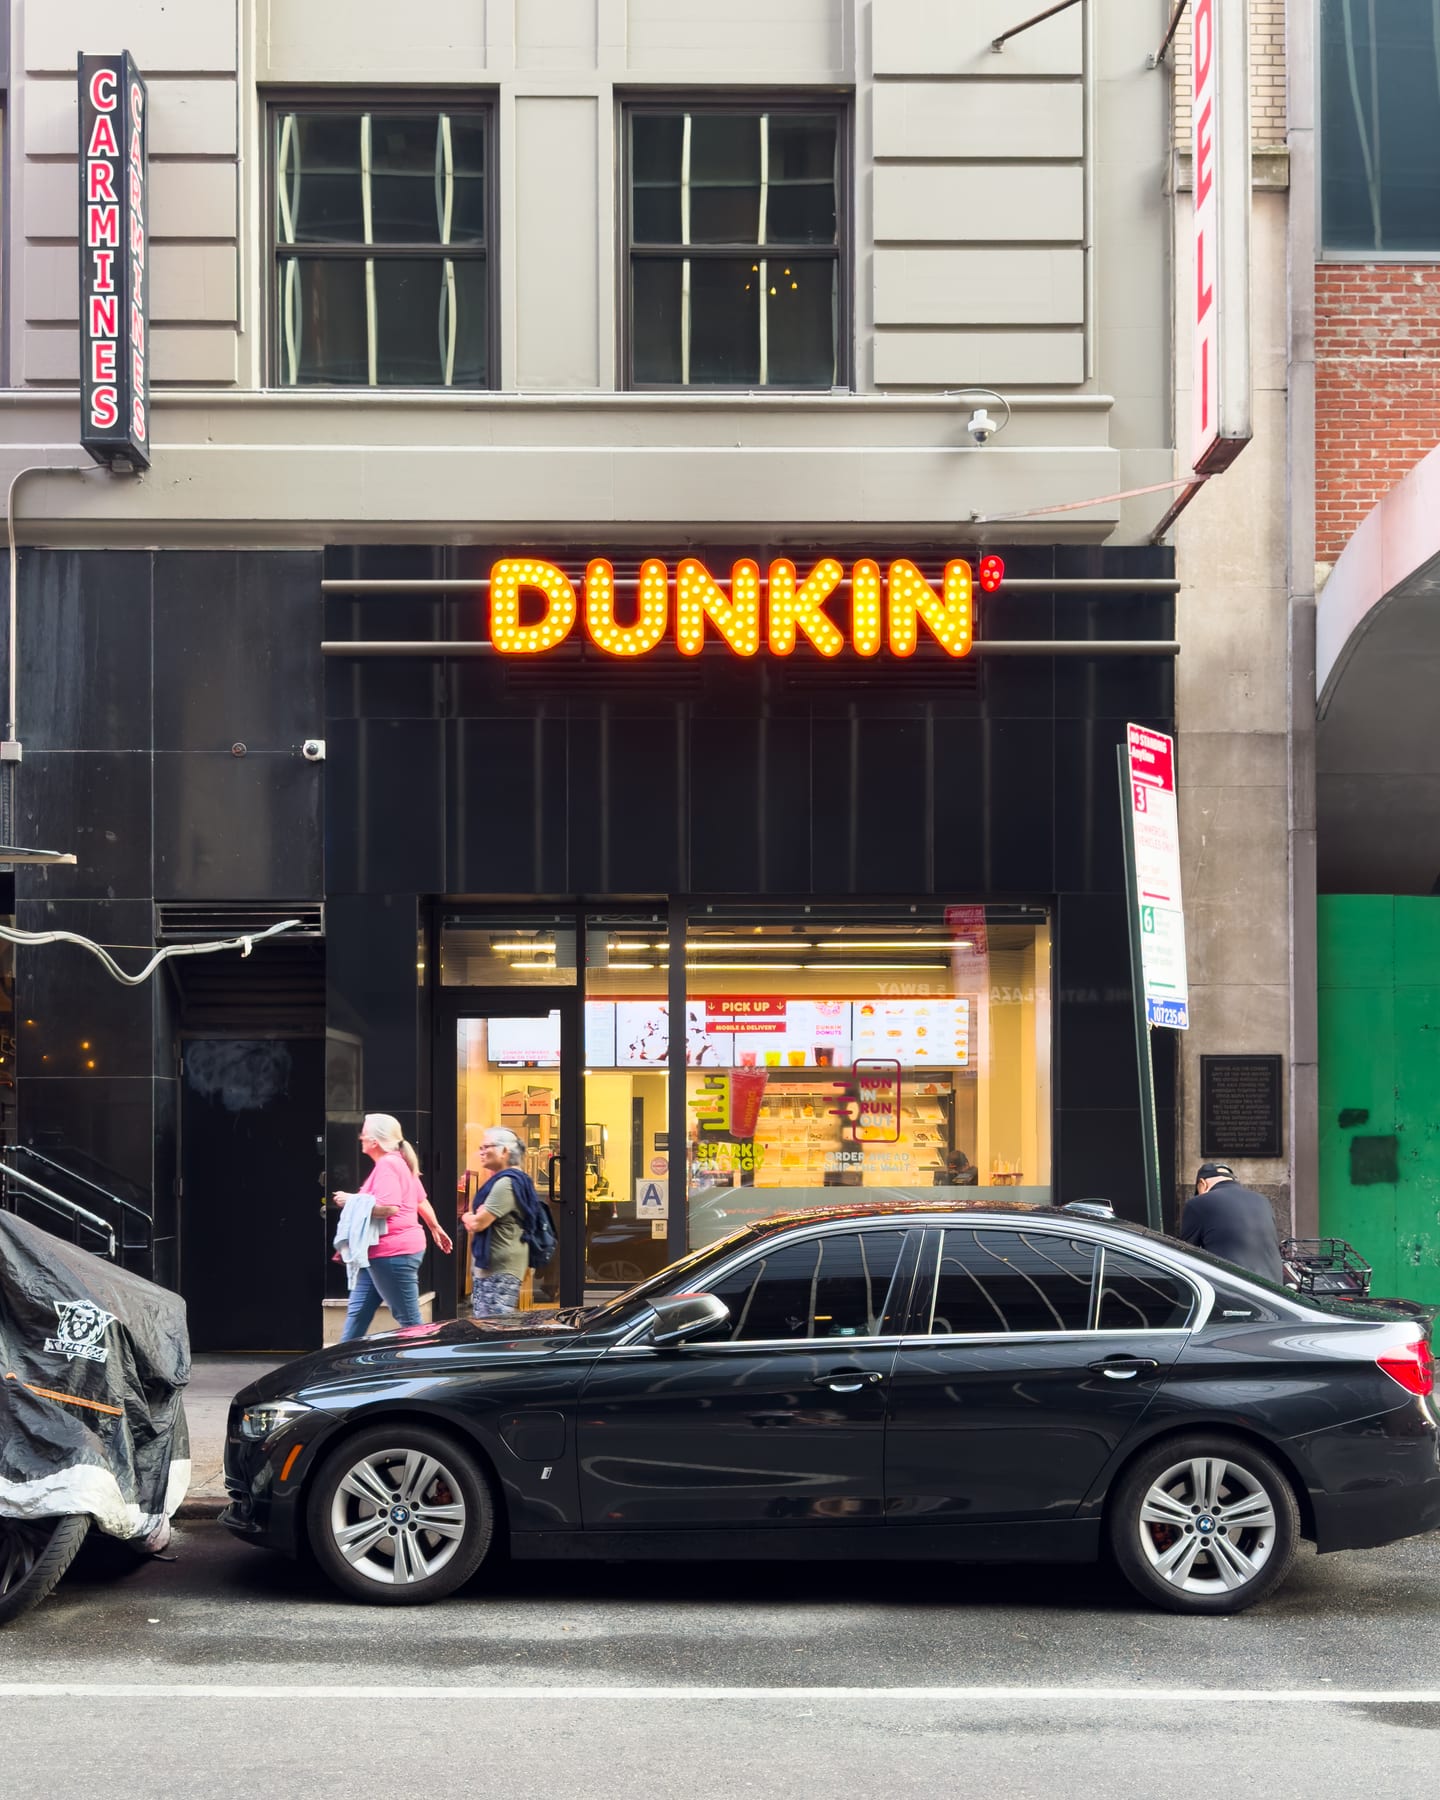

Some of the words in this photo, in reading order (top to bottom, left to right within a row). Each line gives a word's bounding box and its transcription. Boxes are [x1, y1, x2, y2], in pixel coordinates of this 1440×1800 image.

[1195, 0, 1212, 432] DELI
[87, 69, 119, 428] CARMINES
[130, 83, 145, 442] CARMINES
[1136, 786, 1145, 811] 3
[1143, 907, 1153, 933] 6
[722, 1002, 751, 1012] PICK
[753, 1002, 770, 1012] UP
[1152, 1006, 1178, 1025] 107235
[860, 1078, 893, 1089] RUN
[860, 1089, 877, 1101] IN
[860, 1102, 892, 1114] RUN
[859, 1114, 893, 1127] OUT
[825, 1151, 865, 1162] ORDER
[869, 1152, 910, 1162] AHEAD
[853, 1162, 877, 1172] THE
[880, 1162, 911, 1172] WAIT
[642, 1183, 662, 1206] A
